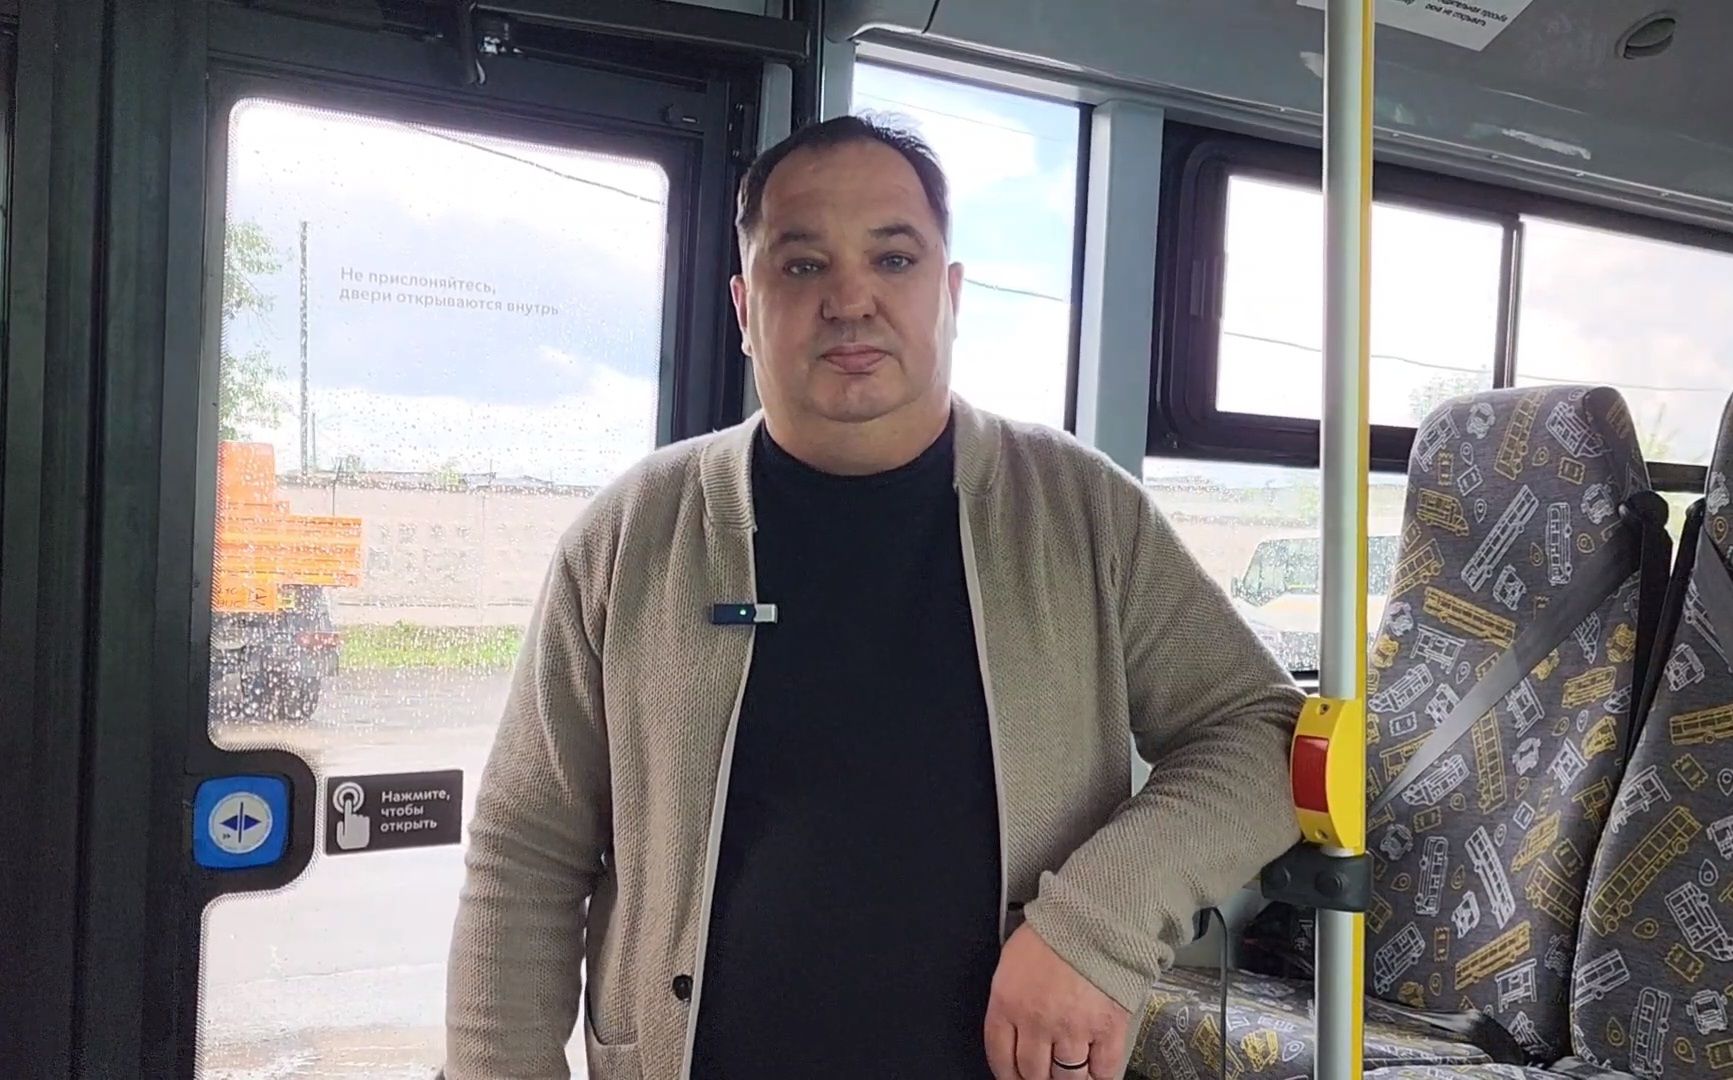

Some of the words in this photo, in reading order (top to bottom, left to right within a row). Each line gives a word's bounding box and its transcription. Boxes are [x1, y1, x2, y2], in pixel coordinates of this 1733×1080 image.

[340, 266, 364, 282] Не
[368, 270, 497, 295] прислоняйтесь,
[338, 287, 392, 304] двери
[396, 291, 503, 311] открываются
[506, 301, 560, 316] внутрь
[381, 789, 451, 803] Нажмите,
[380, 803, 424, 817] чтобы
[380, 819, 438, 833] открыть
